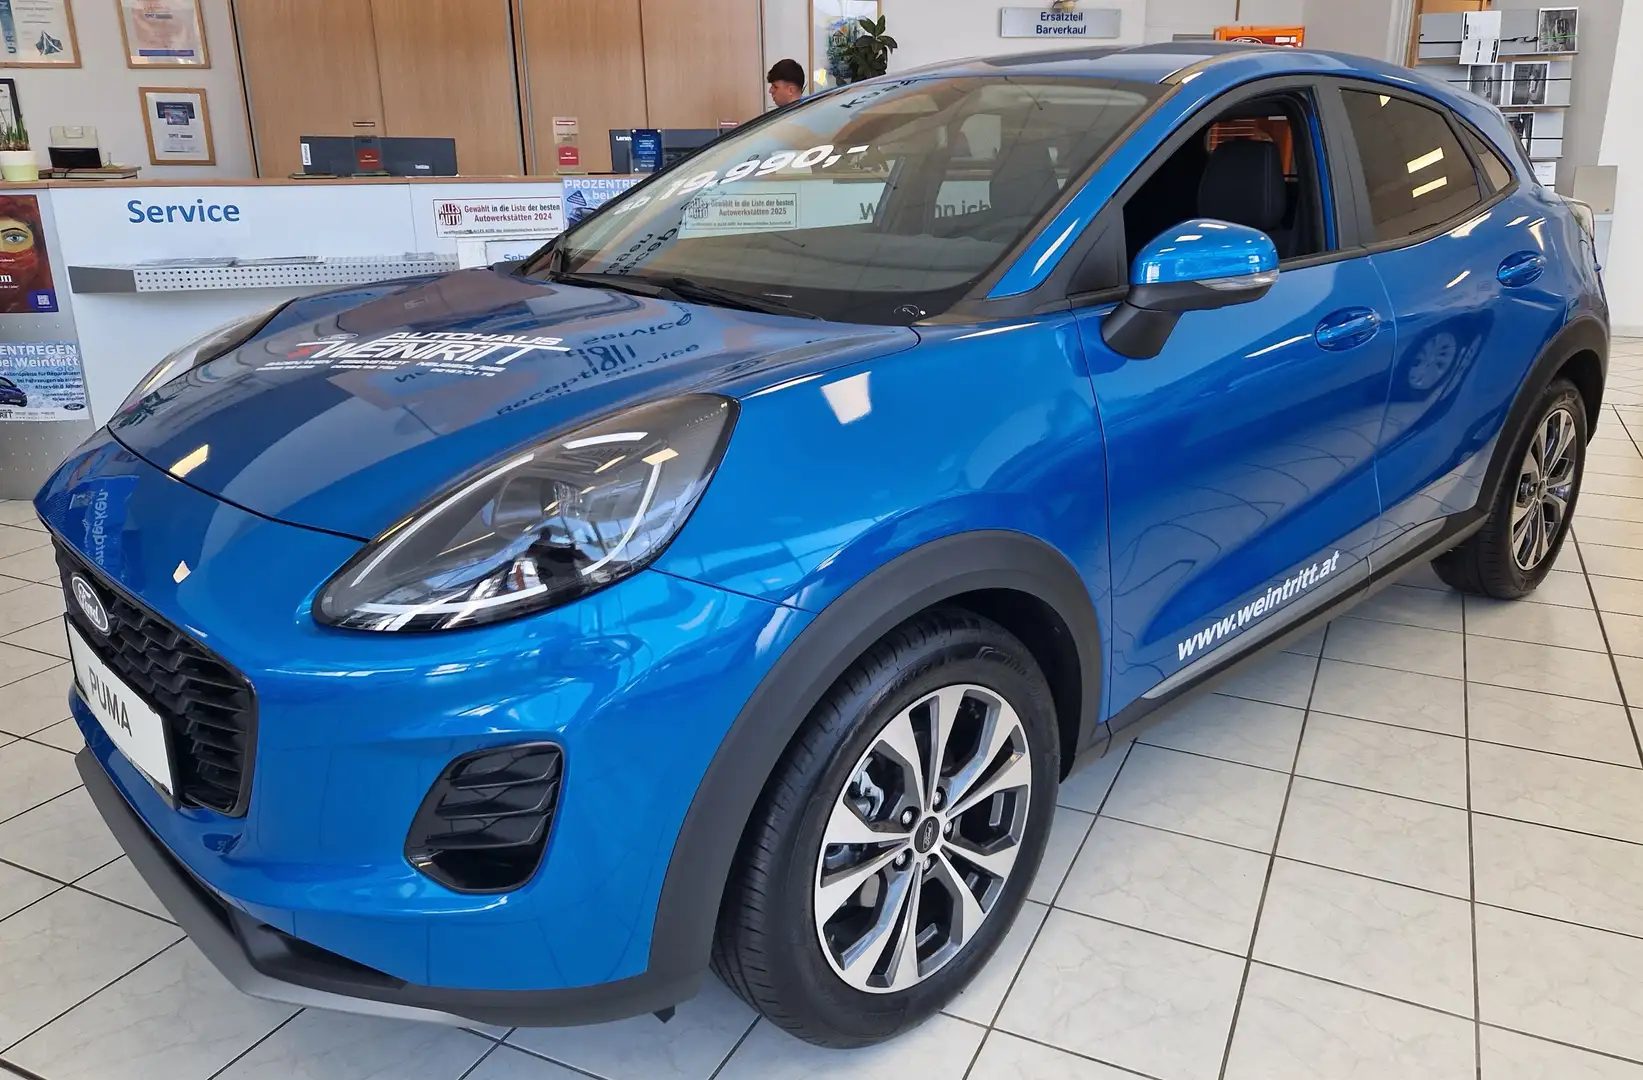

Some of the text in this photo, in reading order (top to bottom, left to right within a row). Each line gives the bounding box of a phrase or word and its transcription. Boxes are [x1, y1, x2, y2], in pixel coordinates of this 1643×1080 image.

[1040, 11, 1083, 21] Ersatzteil
[1036, 25, 1087, 34] Barverkauf
[592, 190, 610, 200] bei
[439, 203, 461, 214] ALLES
[464, 203, 560, 213] Gewählt in die Liste der besten
[711, 200, 733, 208] Gewählt
[741, 199, 751, 207] die
[751, 199, 765, 207] Liste
[127, 199, 241, 224] Service
[719, 208, 769, 216] Autowerkstätten
[440, 214, 462, 226] AUTO
[474, 212, 553, 222] Autowerkstätten 2024
[386, 331, 564, 346] AUTOHAUS
[15, 356, 79, 368] Weintritt
[1177, 550, 1340, 661] www.weintritt.at
[87, 666, 133, 738] PUMA
